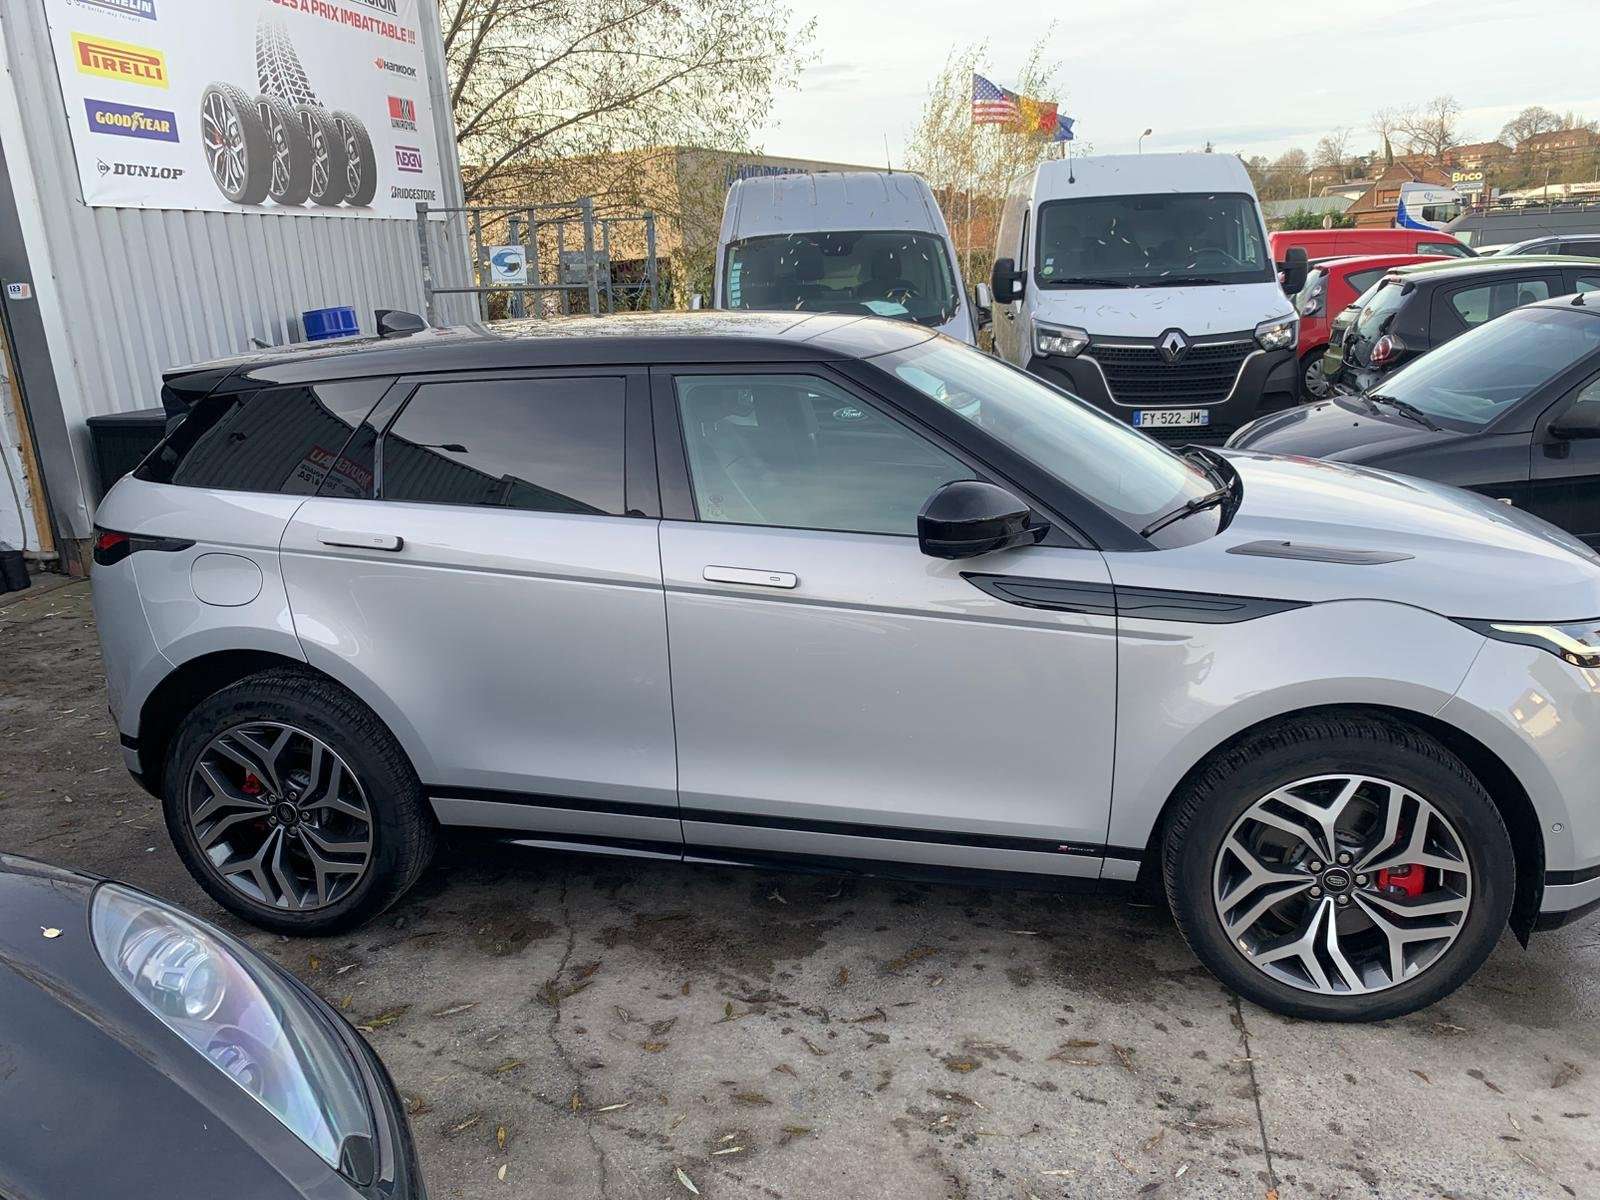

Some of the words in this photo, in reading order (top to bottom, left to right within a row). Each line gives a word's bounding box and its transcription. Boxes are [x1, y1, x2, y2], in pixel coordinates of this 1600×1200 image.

[311, 0, 340, 22] PRIX
[341, 8, 406, 42] IMBATTABLE
[78, 41, 163, 80] PIRELLI
[95, 111, 170, 133] GOODYEAR
[113, 163, 183, 180] DUNLOP
[1452, 172, 1483, 182] Brico
[391, 186, 436, 200] BRIDGESTONE
